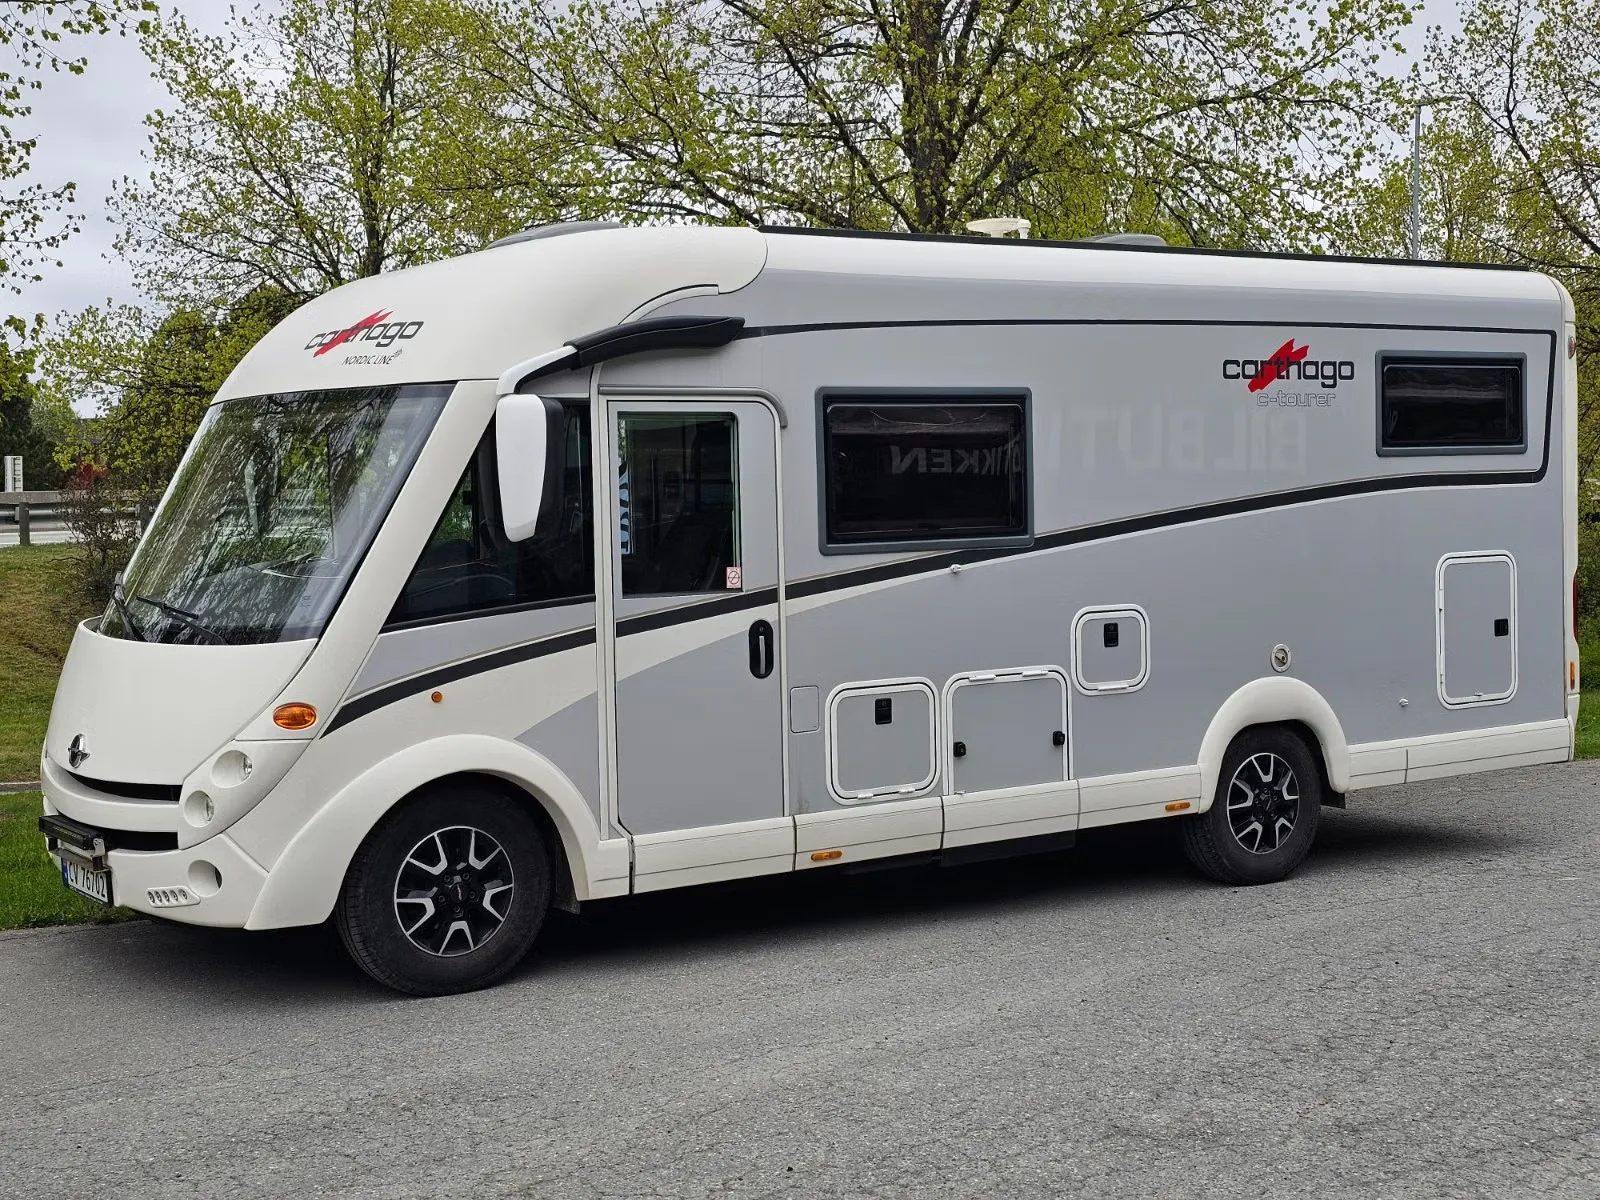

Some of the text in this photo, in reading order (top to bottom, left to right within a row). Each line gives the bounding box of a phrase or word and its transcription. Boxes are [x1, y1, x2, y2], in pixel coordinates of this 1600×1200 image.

[304, 321, 424, 350] carthago
[342, 354, 394, 366] NORDIC LINE
[1223, 356, 1354, 388] carthago
[1256, 390, 1336, 407] c-tourer
[69, 861, 78, 884] CV
[81, 866, 106, 897] 76702
